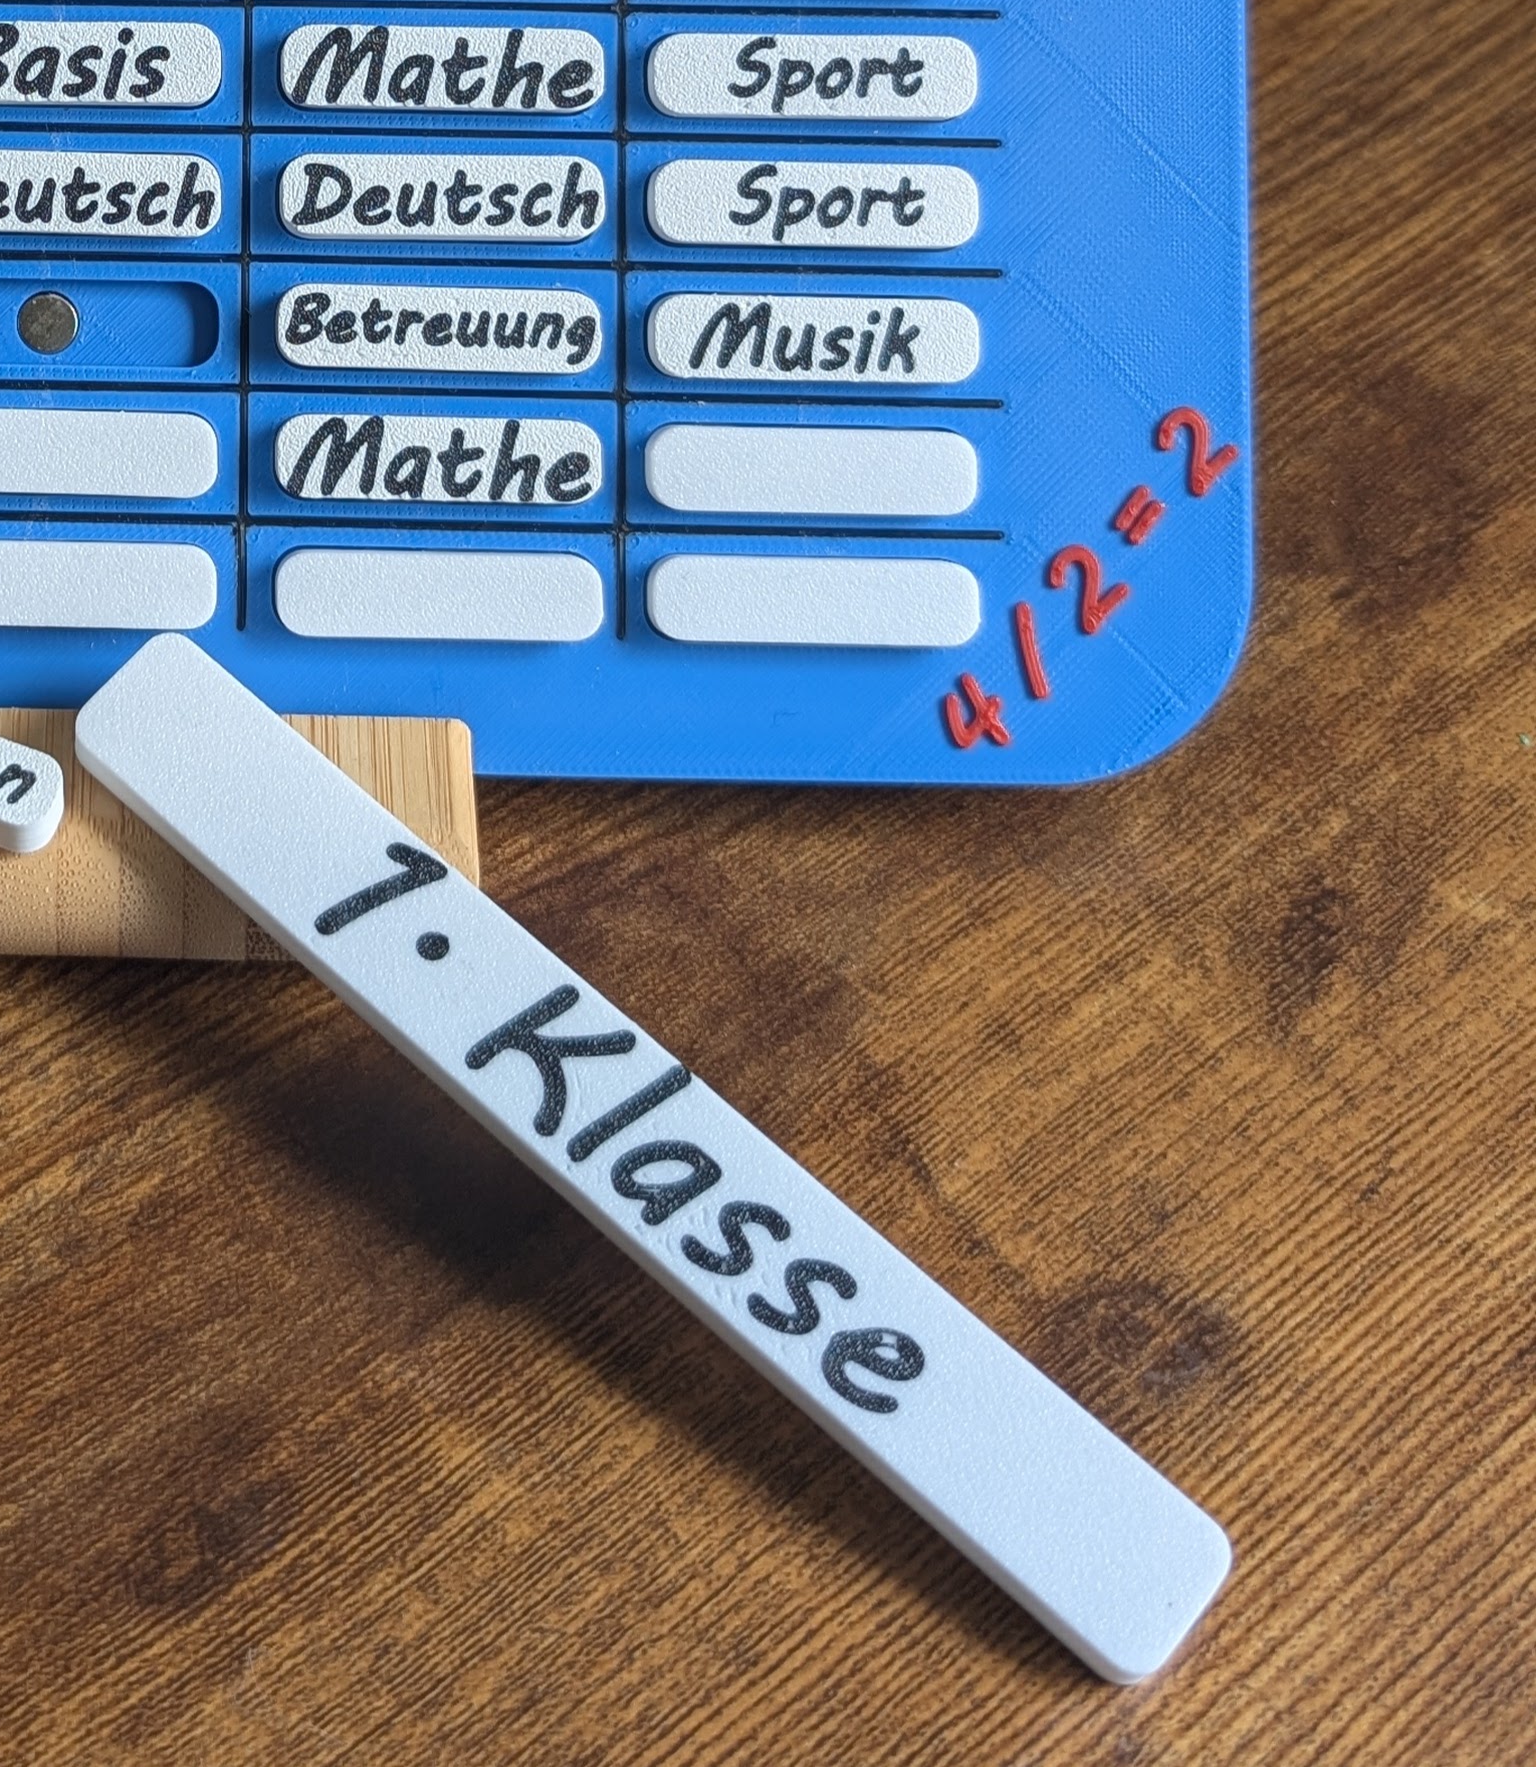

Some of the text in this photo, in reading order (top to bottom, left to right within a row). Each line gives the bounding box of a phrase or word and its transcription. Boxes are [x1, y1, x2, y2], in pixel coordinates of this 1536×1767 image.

[292, 28, 596, 109] Mathe
[730, 38, 926, 110] Sport
[298, 163, 601, 229] Deutsch
[731, 166, 926, 241] Sport
[285, 293, 598, 365] Betreuung
[690, 305, 916, 374] Musik
[286, 418, 593, 502] Mathe
[314, 841, 925, 1413] 1. Klasse
